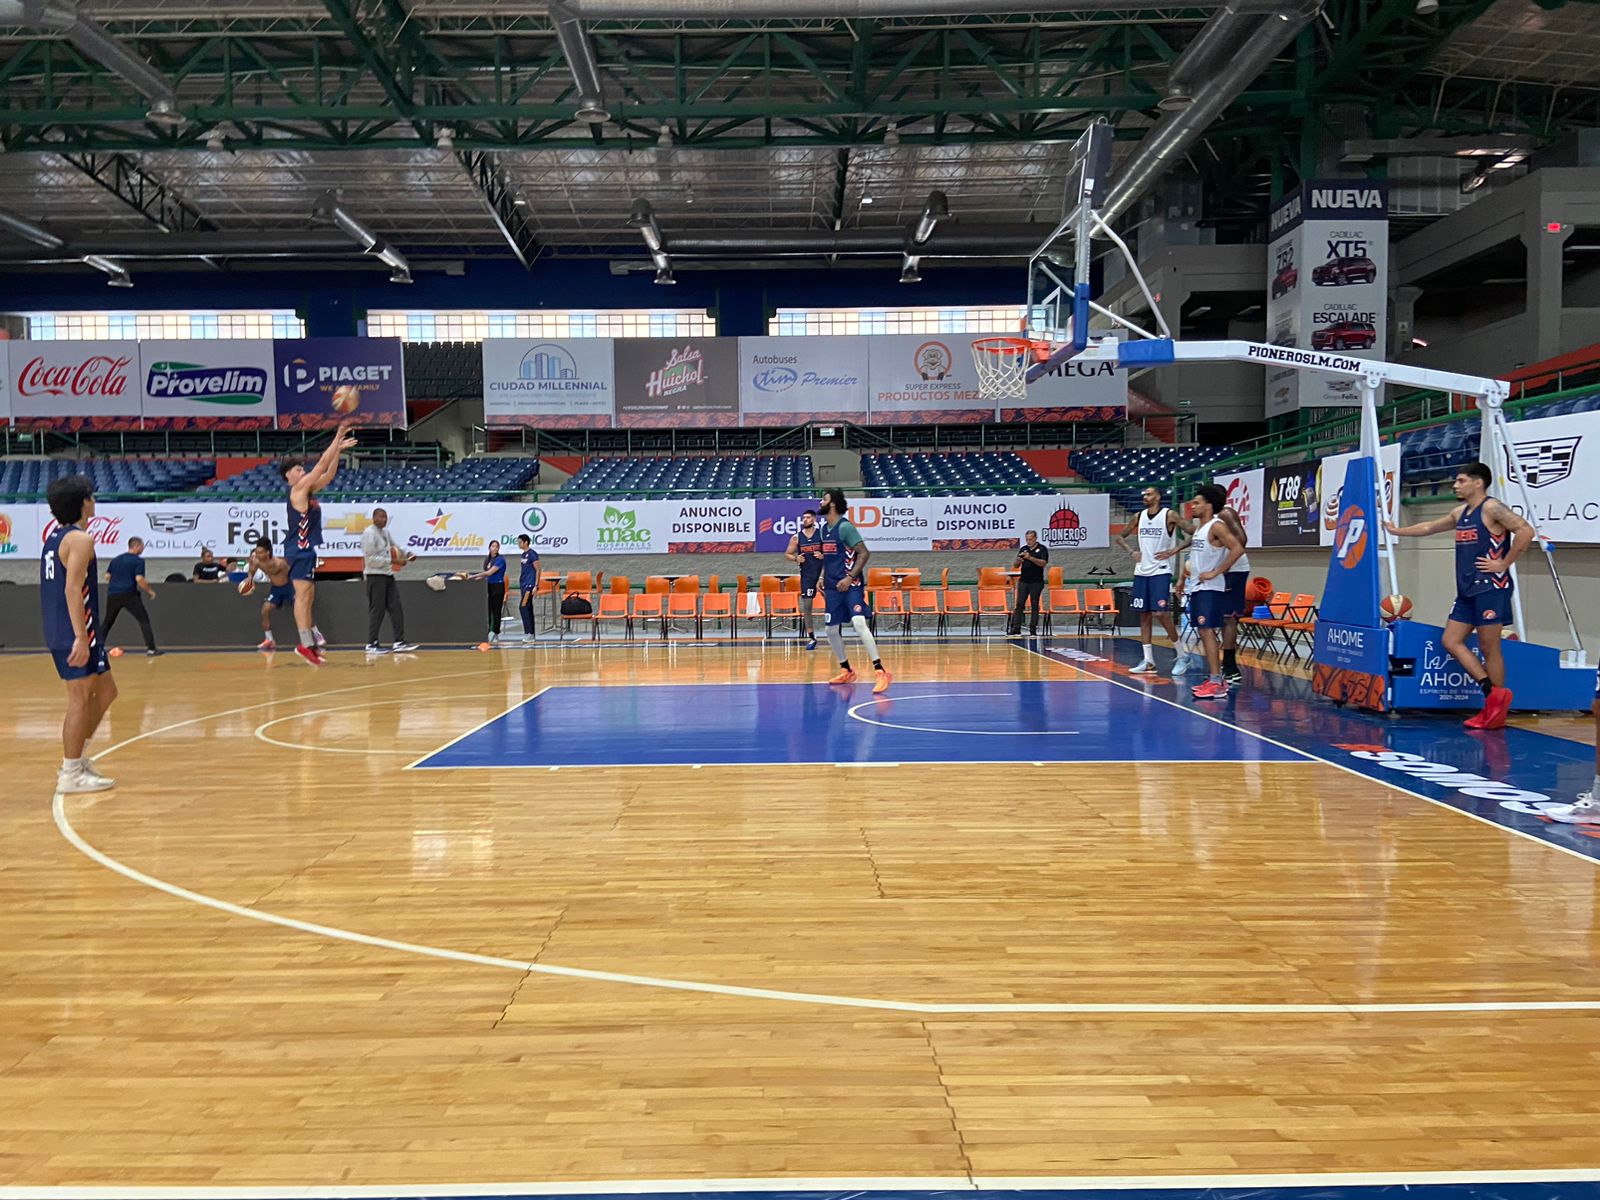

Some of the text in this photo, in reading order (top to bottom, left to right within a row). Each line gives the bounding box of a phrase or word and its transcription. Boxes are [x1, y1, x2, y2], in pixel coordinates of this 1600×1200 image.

[1311, 189, 1382, 208] NUEVA
[1271, 195, 1302, 232] NUEVA
[1326, 240, 1367, 259] XT5
[1313, 312, 1376, 323] ESCALADE
[753, 354, 798, 364] Autobuses
[1248, 345, 1361, 372] PIONEROSLM.COM
[319, 365, 392, 381] PIAGET
[801, 372, 858, 386] Premier
[150, 370, 263, 395] Provelim
[489, 381, 607, 391] CIUDAD MILLENNIAL
[878, 390, 981, 401] PRODUCTOS MEZ
[228, 506, 269, 520] Grupo
[679, 506, 743, 518] ANUNCIO
[882, 505, 914, 516] Línea
[943, 503, 1008, 515] ANUNCIO
[672, 522, 751, 533] DISPONIBLE
[882, 517, 928, 528] Directa
[936, 519, 1016, 531] DISPONIBLE
[597, 527, 651, 543] mac
[1041, 527, 1088, 542] PIONEROS
[144, 540, 217, 549] ADILLAC
[1327, 628, 1364, 648] AHOME
[1420, 672, 1479, 687] AHOM
